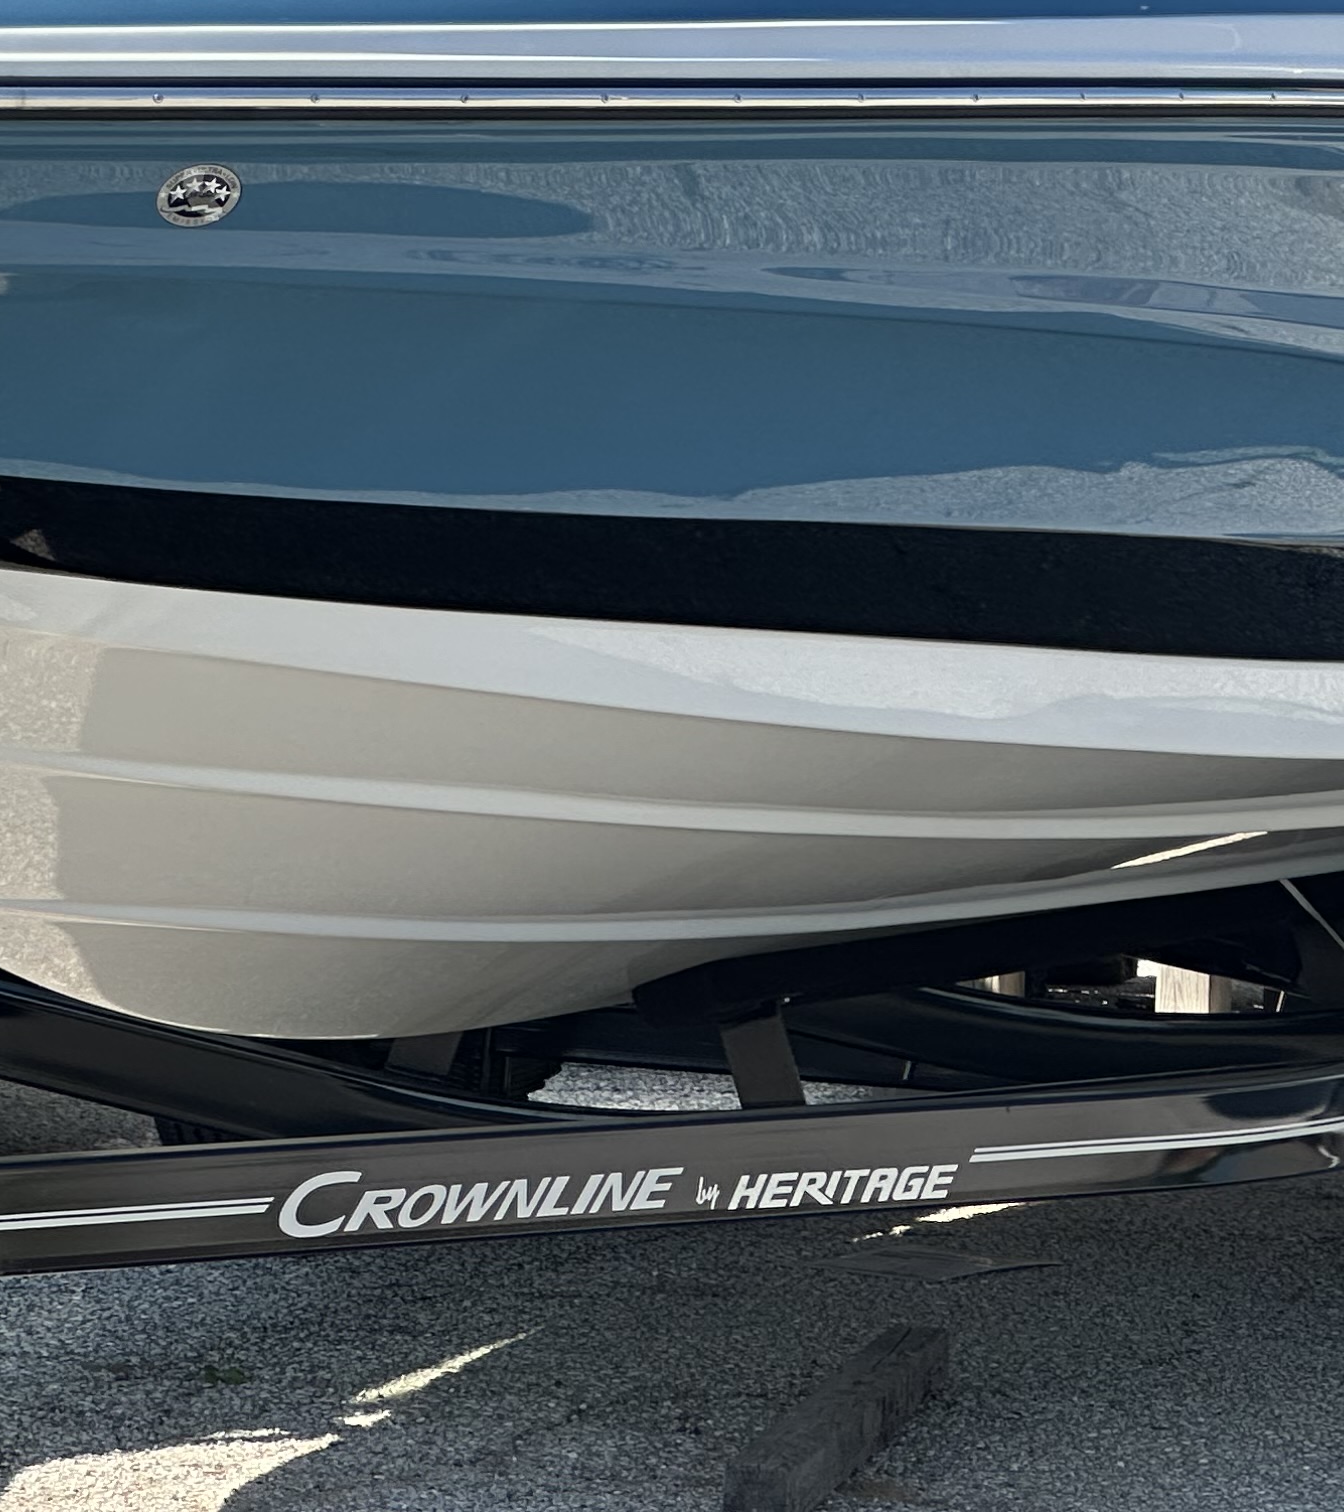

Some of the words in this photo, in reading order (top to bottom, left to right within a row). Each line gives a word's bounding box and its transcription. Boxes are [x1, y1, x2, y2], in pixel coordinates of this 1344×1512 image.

[278, 1170, 684, 1239] CROWNLINE
[695, 1176, 720, 1210] by
[728, 1164, 958, 1211] HERITAGE
